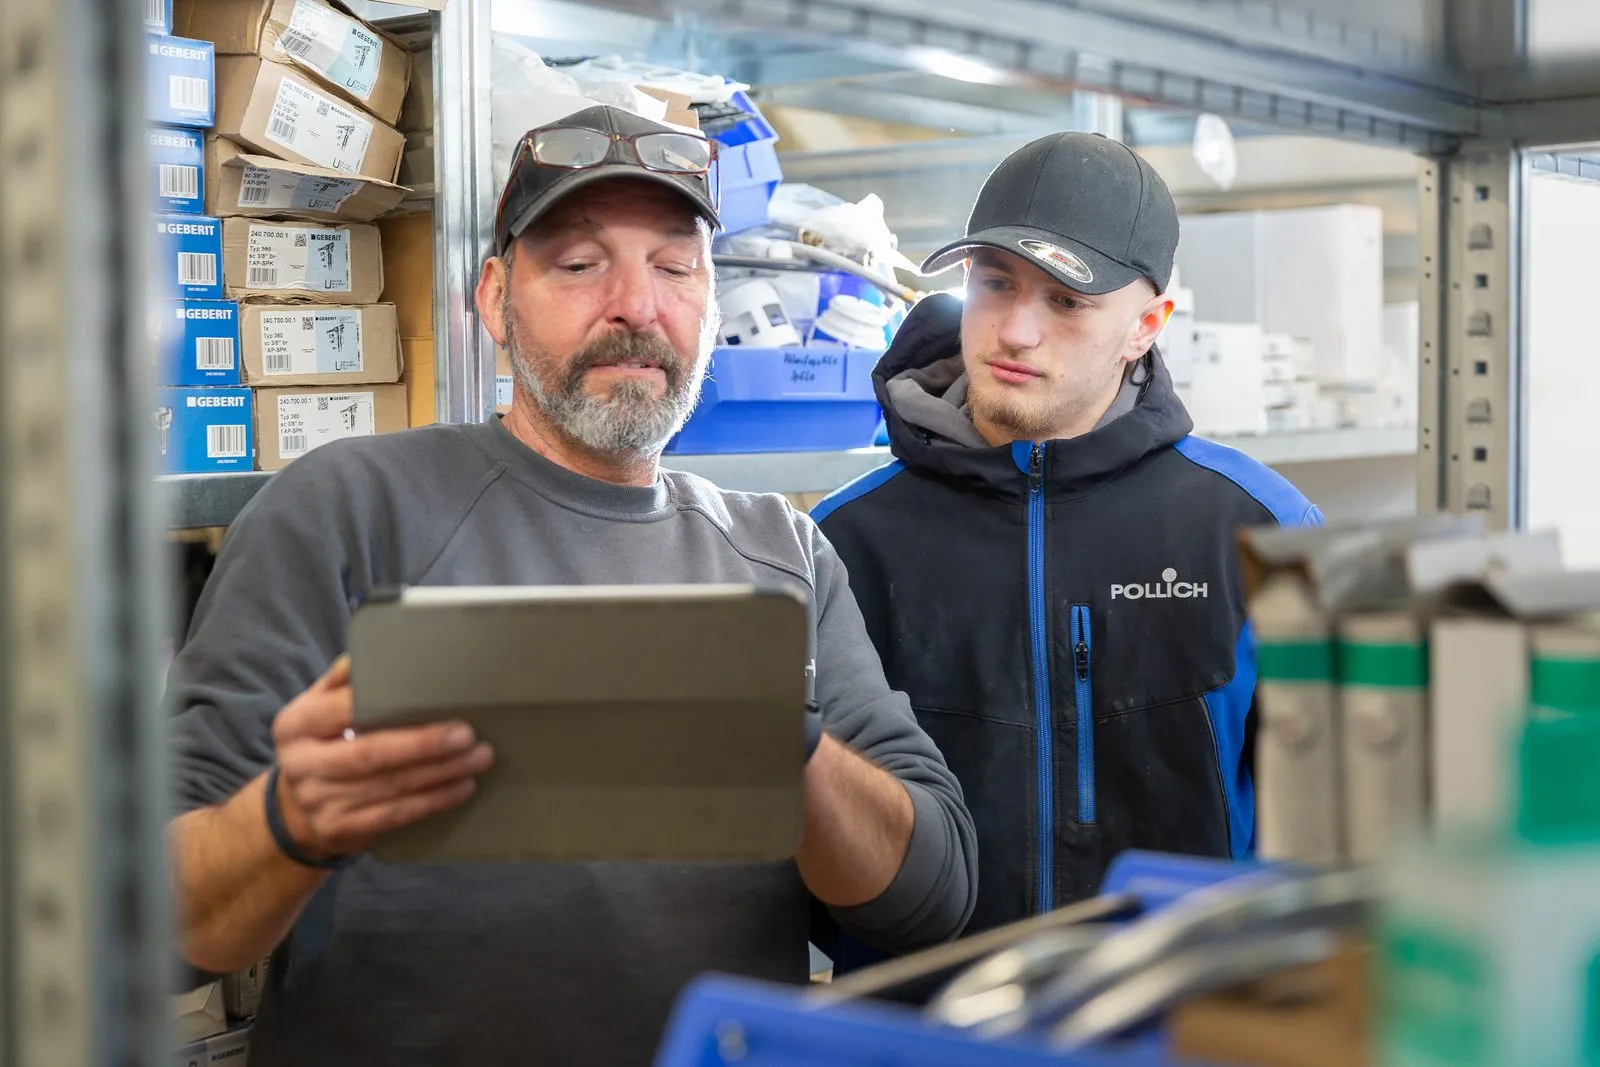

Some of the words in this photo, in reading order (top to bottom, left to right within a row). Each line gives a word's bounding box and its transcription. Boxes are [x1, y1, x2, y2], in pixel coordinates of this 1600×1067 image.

[356, 31, 378, 48] GEBERIT
[160, 45, 208, 61] GEBERIT
[149, 134, 197, 149] GEBERIT
[167, 223, 215, 236] GEBERIT
[250, 230, 289, 239] 240.700.00.1
[185, 308, 233, 320] GEBERIT
[197, 396, 245, 408] GEBERIT
[279, 397, 312, 405] 240.700.00.1
[1110, 567, 1208, 600] POLLICH
